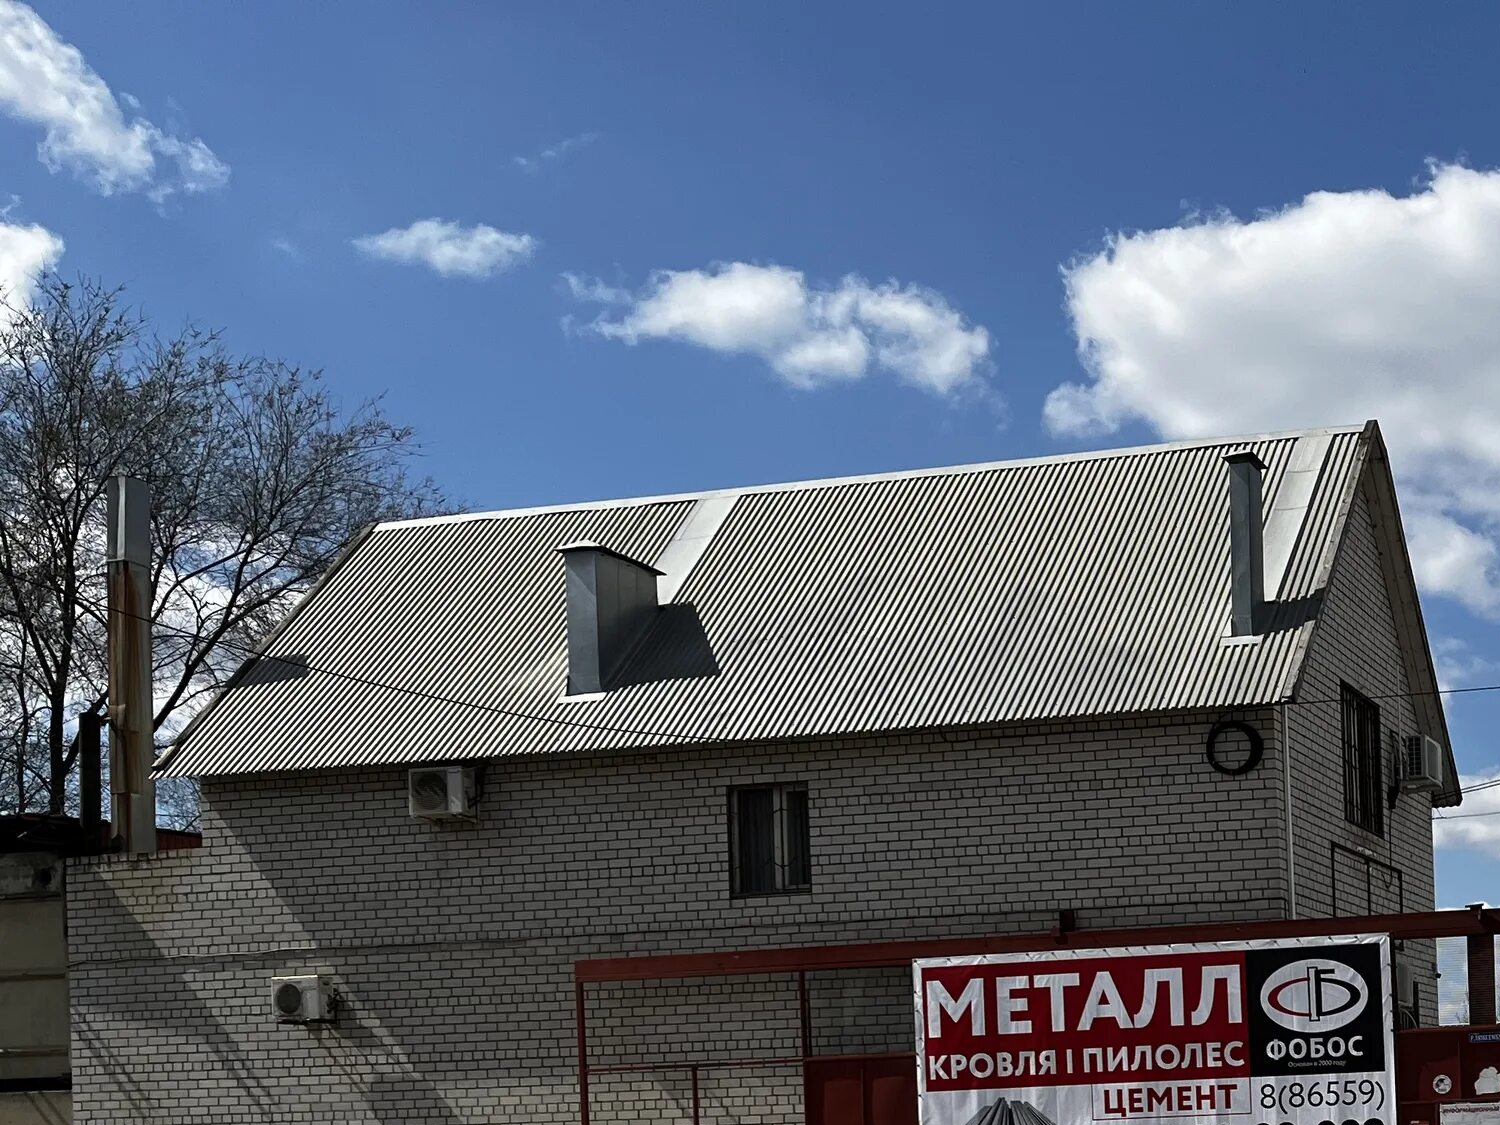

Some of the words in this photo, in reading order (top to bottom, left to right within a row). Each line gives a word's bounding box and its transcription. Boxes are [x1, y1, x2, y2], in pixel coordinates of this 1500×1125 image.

[925, 964, 1242, 1038] МЕТАЛЛ
[929, 1050, 1057, 1080] КРОВЛЯ
[1083, 1041, 1245, 1072] ПИЛОЛЕС
[1266, 1035, 1364, 1060] ФОБОС
[1104, 1084, 1238, 1117] ЦЕМЕНТ
[1260, 1079, 1385, 1114] 8(86559)
